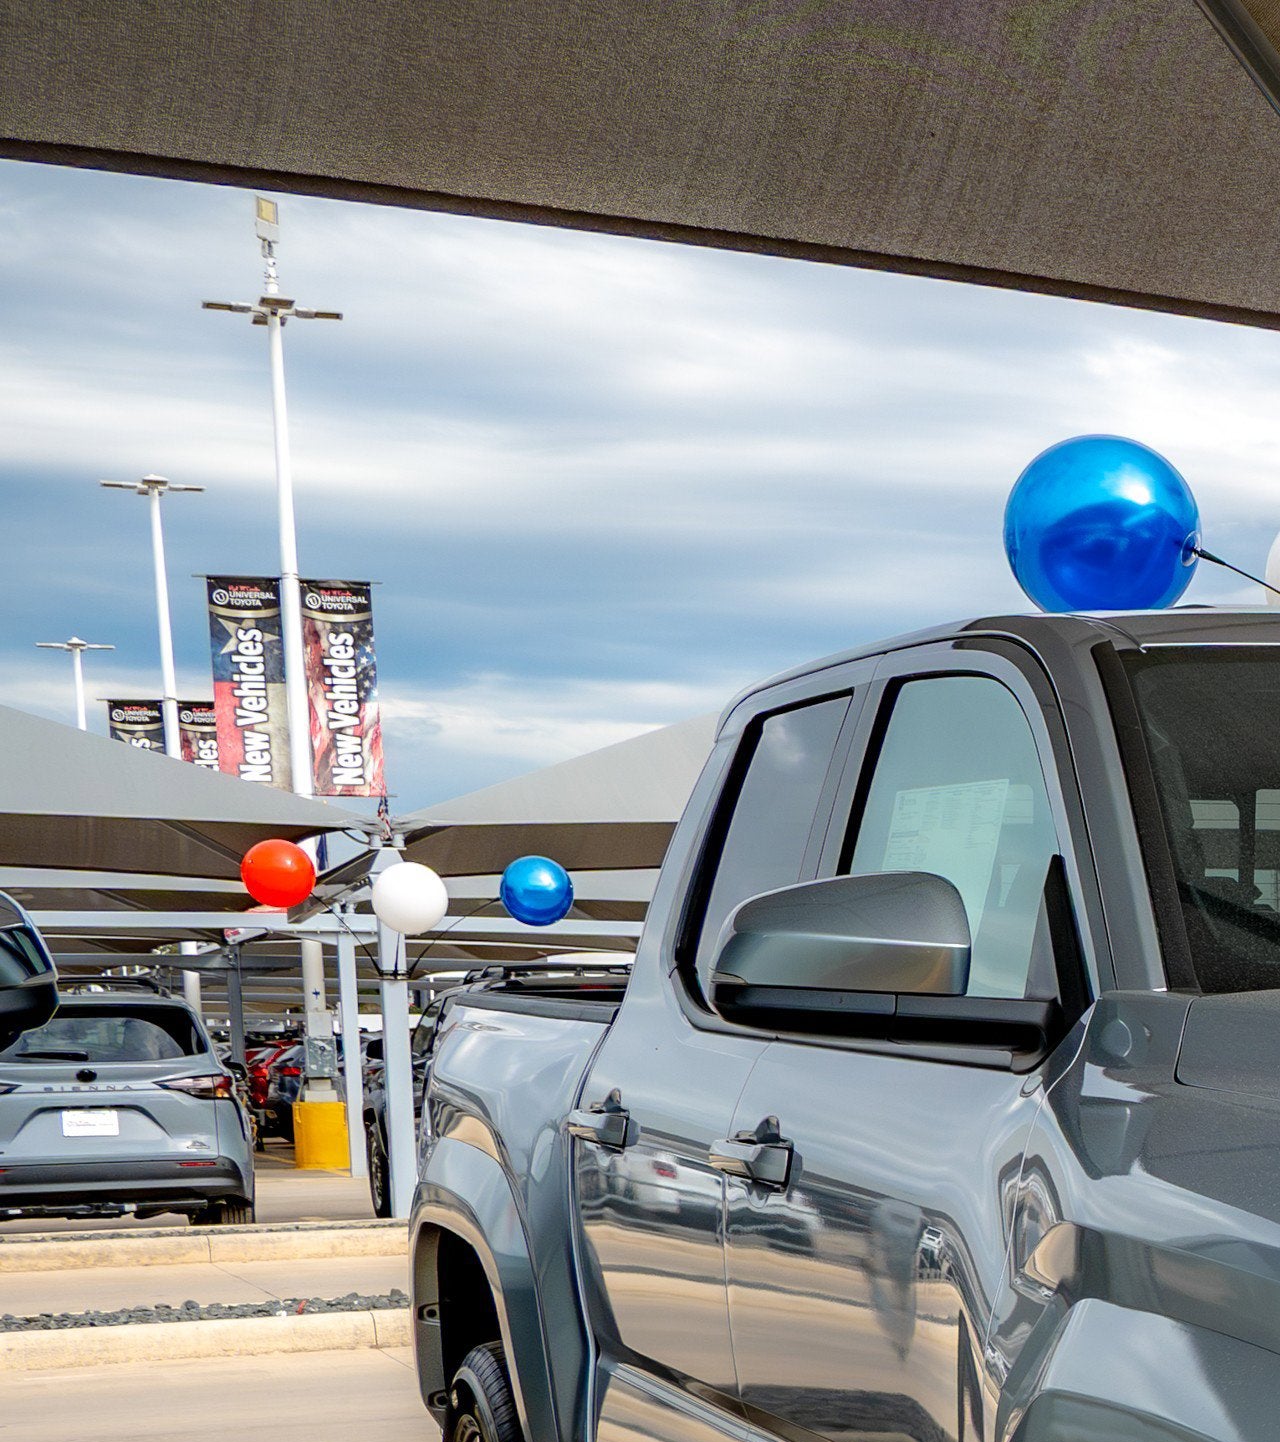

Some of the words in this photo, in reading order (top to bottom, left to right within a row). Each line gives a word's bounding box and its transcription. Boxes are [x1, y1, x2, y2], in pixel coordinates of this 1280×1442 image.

[229, 591, 276, 599] UNIVERSAL
[321, 595, 368, 604] UNIVERSAL
[230, 627, 270, 726] Vehicles
[322, 632, 361, 730] Vehicles
[239, 729, 273, 782] New
[331, 732, 365, 786] New
[43, 1084, 134, 1092] SIENNA
